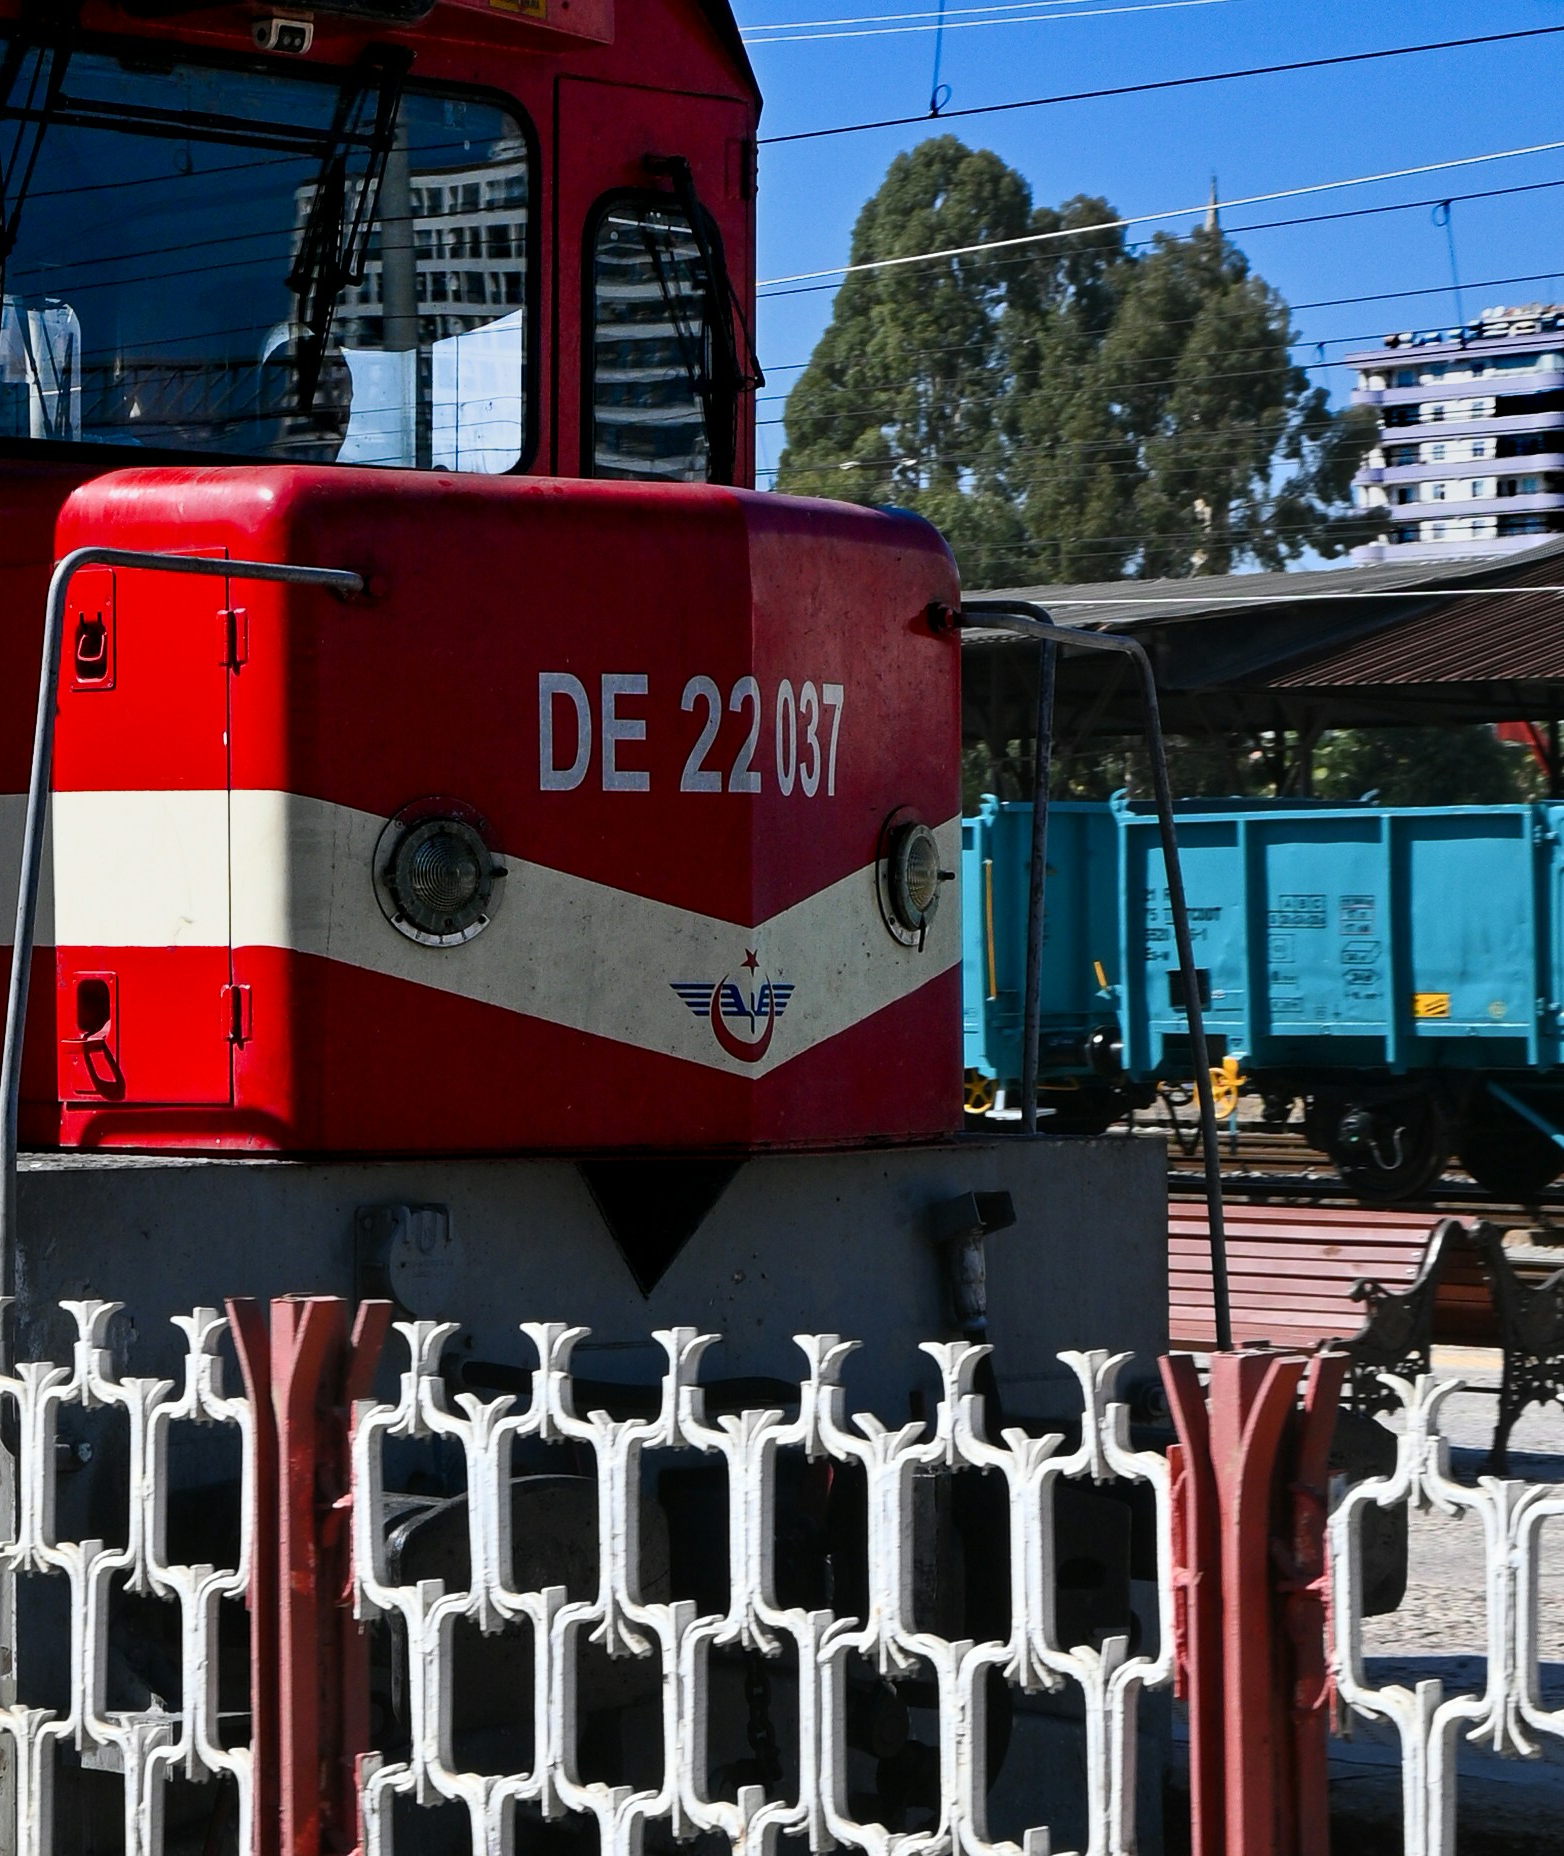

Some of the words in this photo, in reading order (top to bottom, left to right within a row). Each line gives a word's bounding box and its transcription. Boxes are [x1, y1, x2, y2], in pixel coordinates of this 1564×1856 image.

[539, 672, 650, 791] DE
[680, 675, 762, 793] 22
[776, 679, 844, 797] 037
